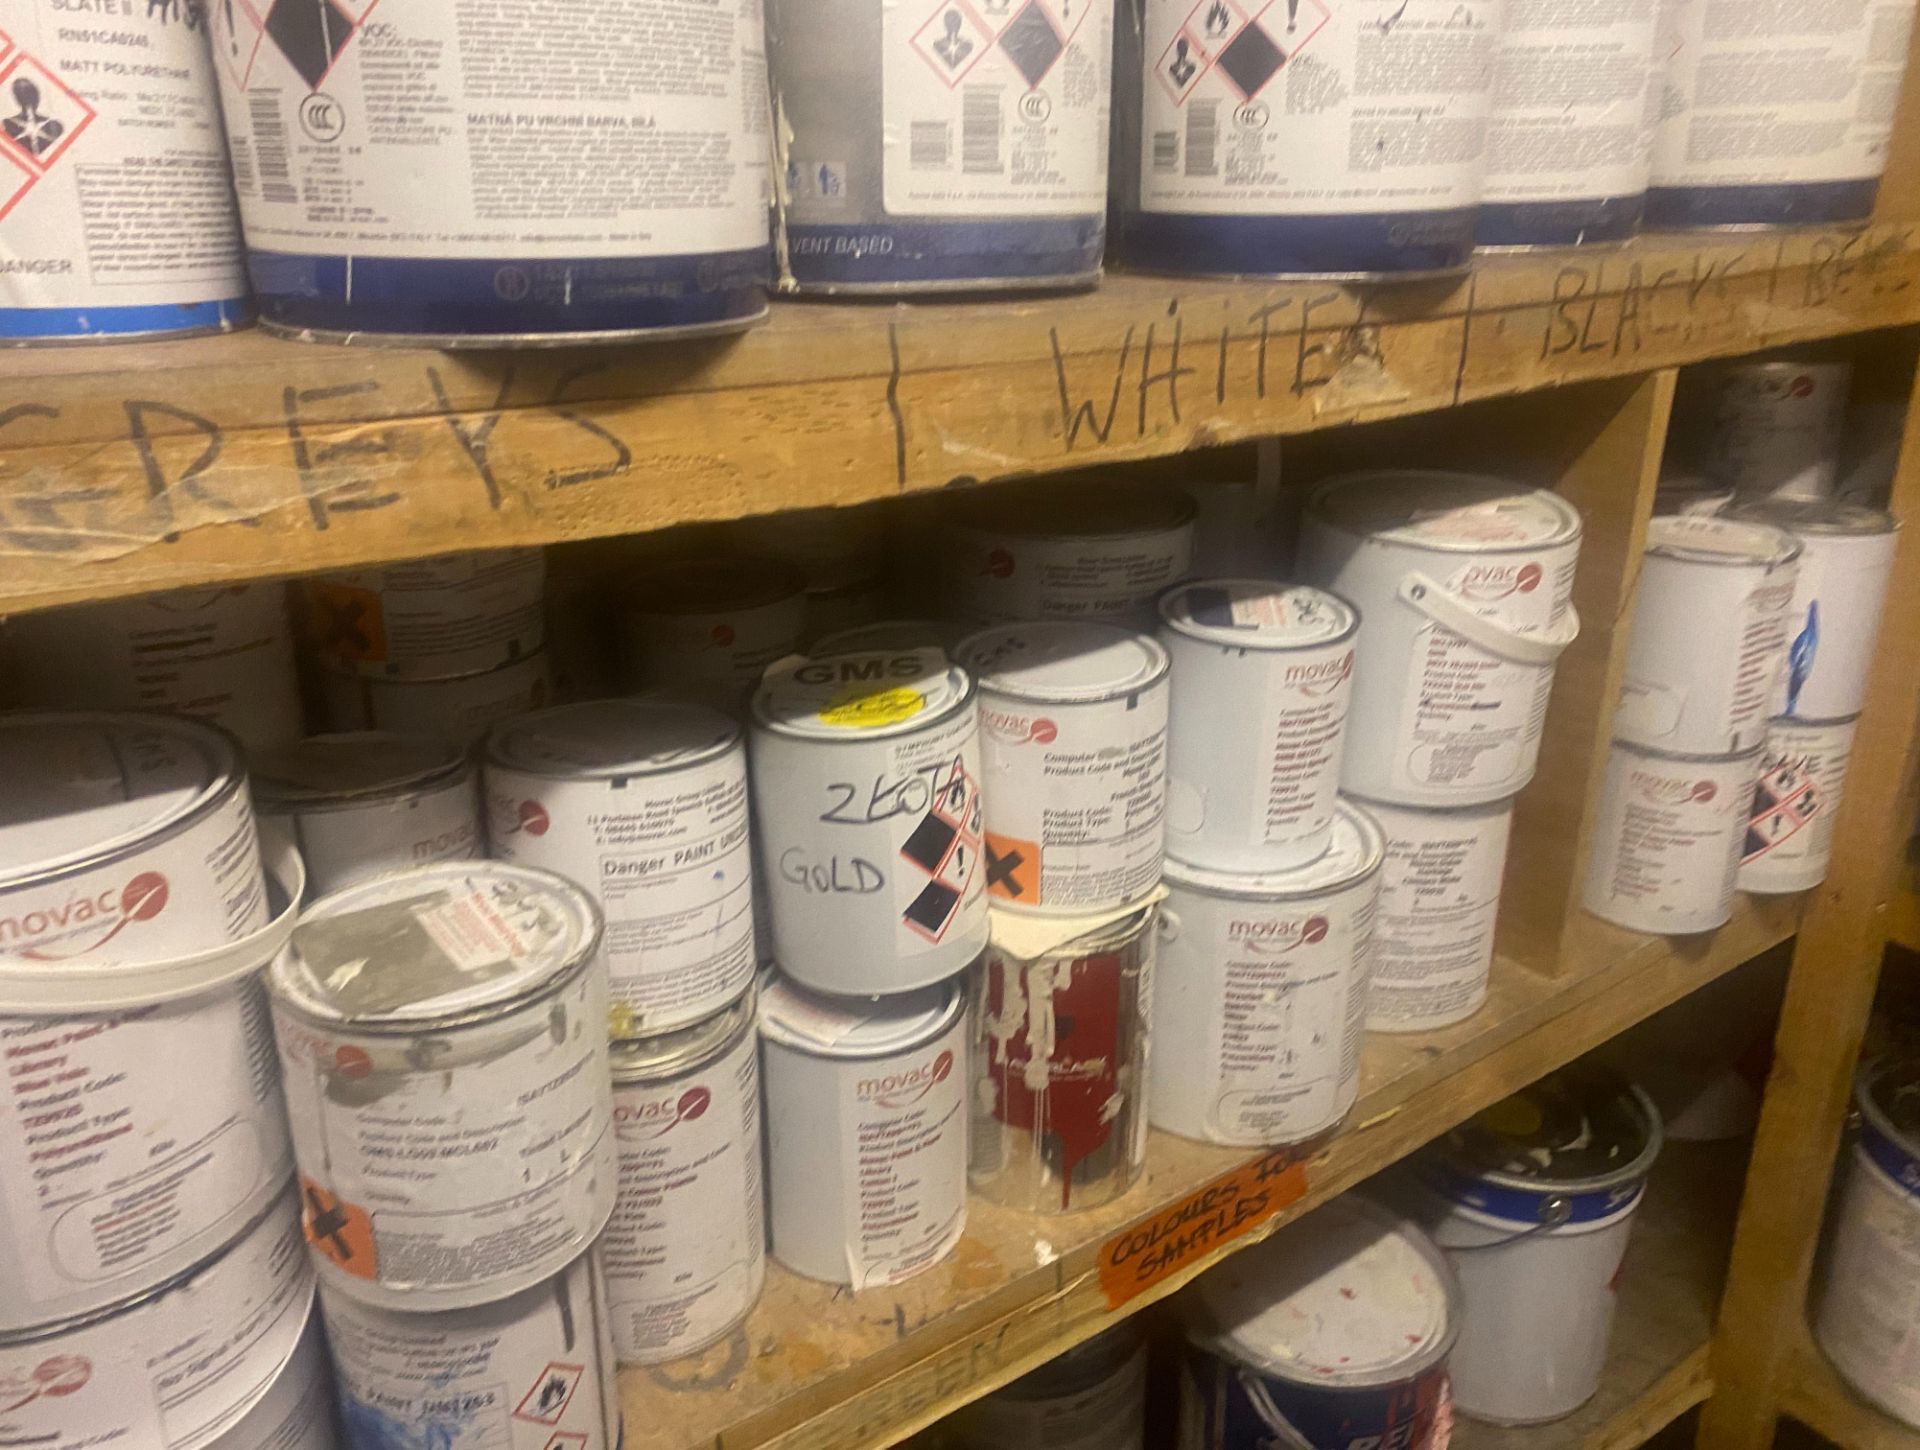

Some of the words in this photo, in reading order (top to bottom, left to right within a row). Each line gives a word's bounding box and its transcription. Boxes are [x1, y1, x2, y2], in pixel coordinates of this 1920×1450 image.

[793, 655, 925, 685] GMS
[604, 855, 667, 877] Danger
[674, 839, 716, 866] PAINT
[779, 848, 886, 894] GOLD
[856, 1062, 932, 1096] movac
[613, 1098, 676, 1122] ovac
[1135, 1188, 1272, 1283] SAMPLES
